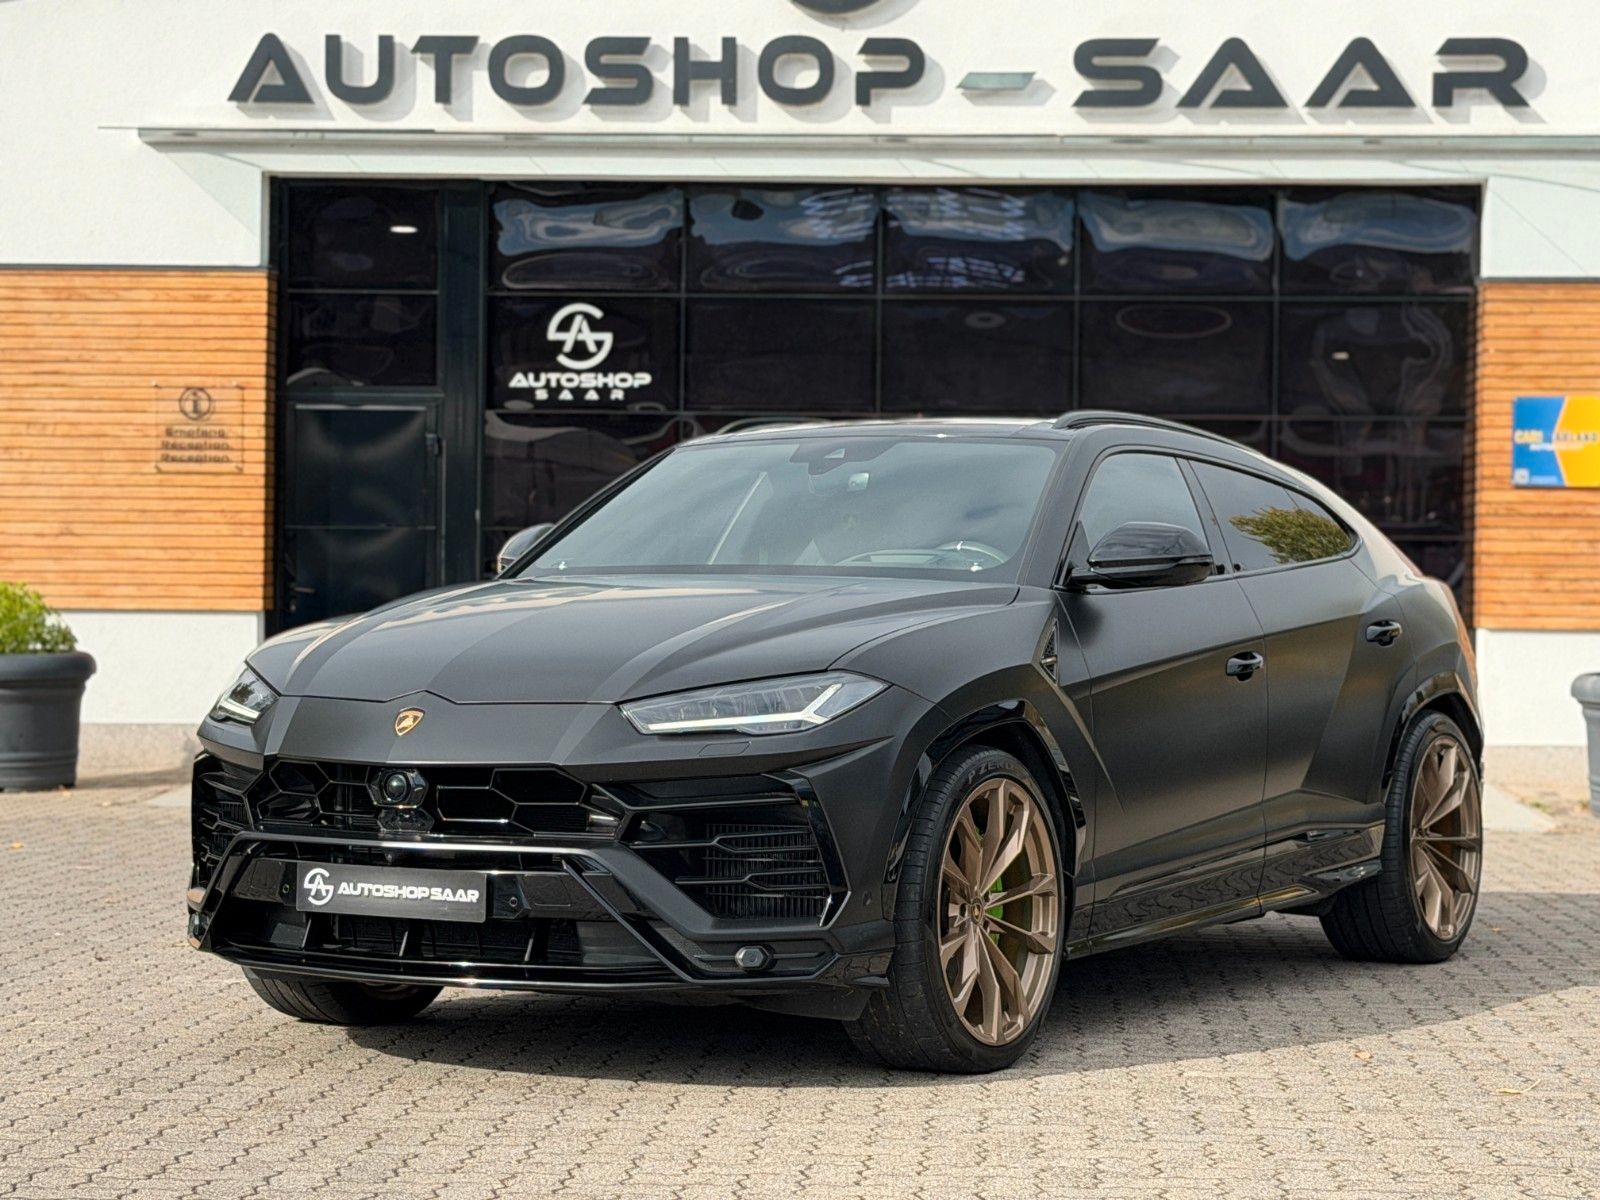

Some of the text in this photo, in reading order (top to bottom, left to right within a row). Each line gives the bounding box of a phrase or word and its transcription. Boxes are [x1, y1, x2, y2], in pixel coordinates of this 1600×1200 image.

[227, 33, 926, 107] AUTOSHOP
[1072, 36, 1531, 108] SAAR
[508, 371, 653, 388] AUTOSHOP
[534, 388, 625, 401] SAAR
